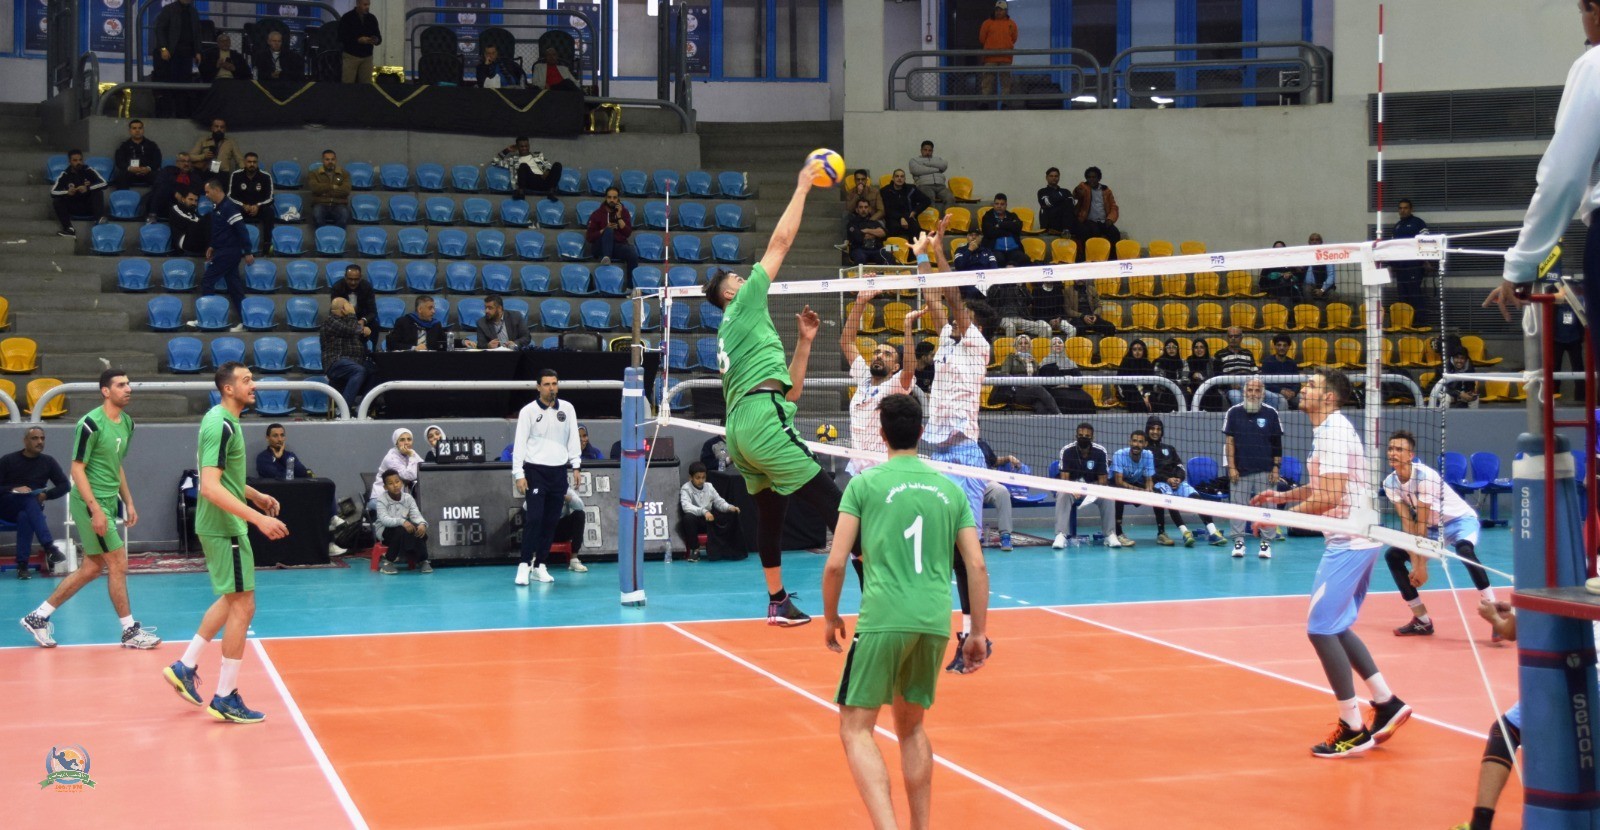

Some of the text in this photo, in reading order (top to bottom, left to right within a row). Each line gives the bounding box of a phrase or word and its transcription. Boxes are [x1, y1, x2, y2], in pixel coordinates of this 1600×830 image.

[1322, 250, 1350, 261] Senoh
[116, 437, 122, 453] 7
[439, 442, 483, 455] 23 1 1 8
[443, 506, 480, 519] HOME
[1521, 486, 1530, 539] senoh
[903, 515, 923, 574] 1
[1572, 693, 1593, 769] senoh
